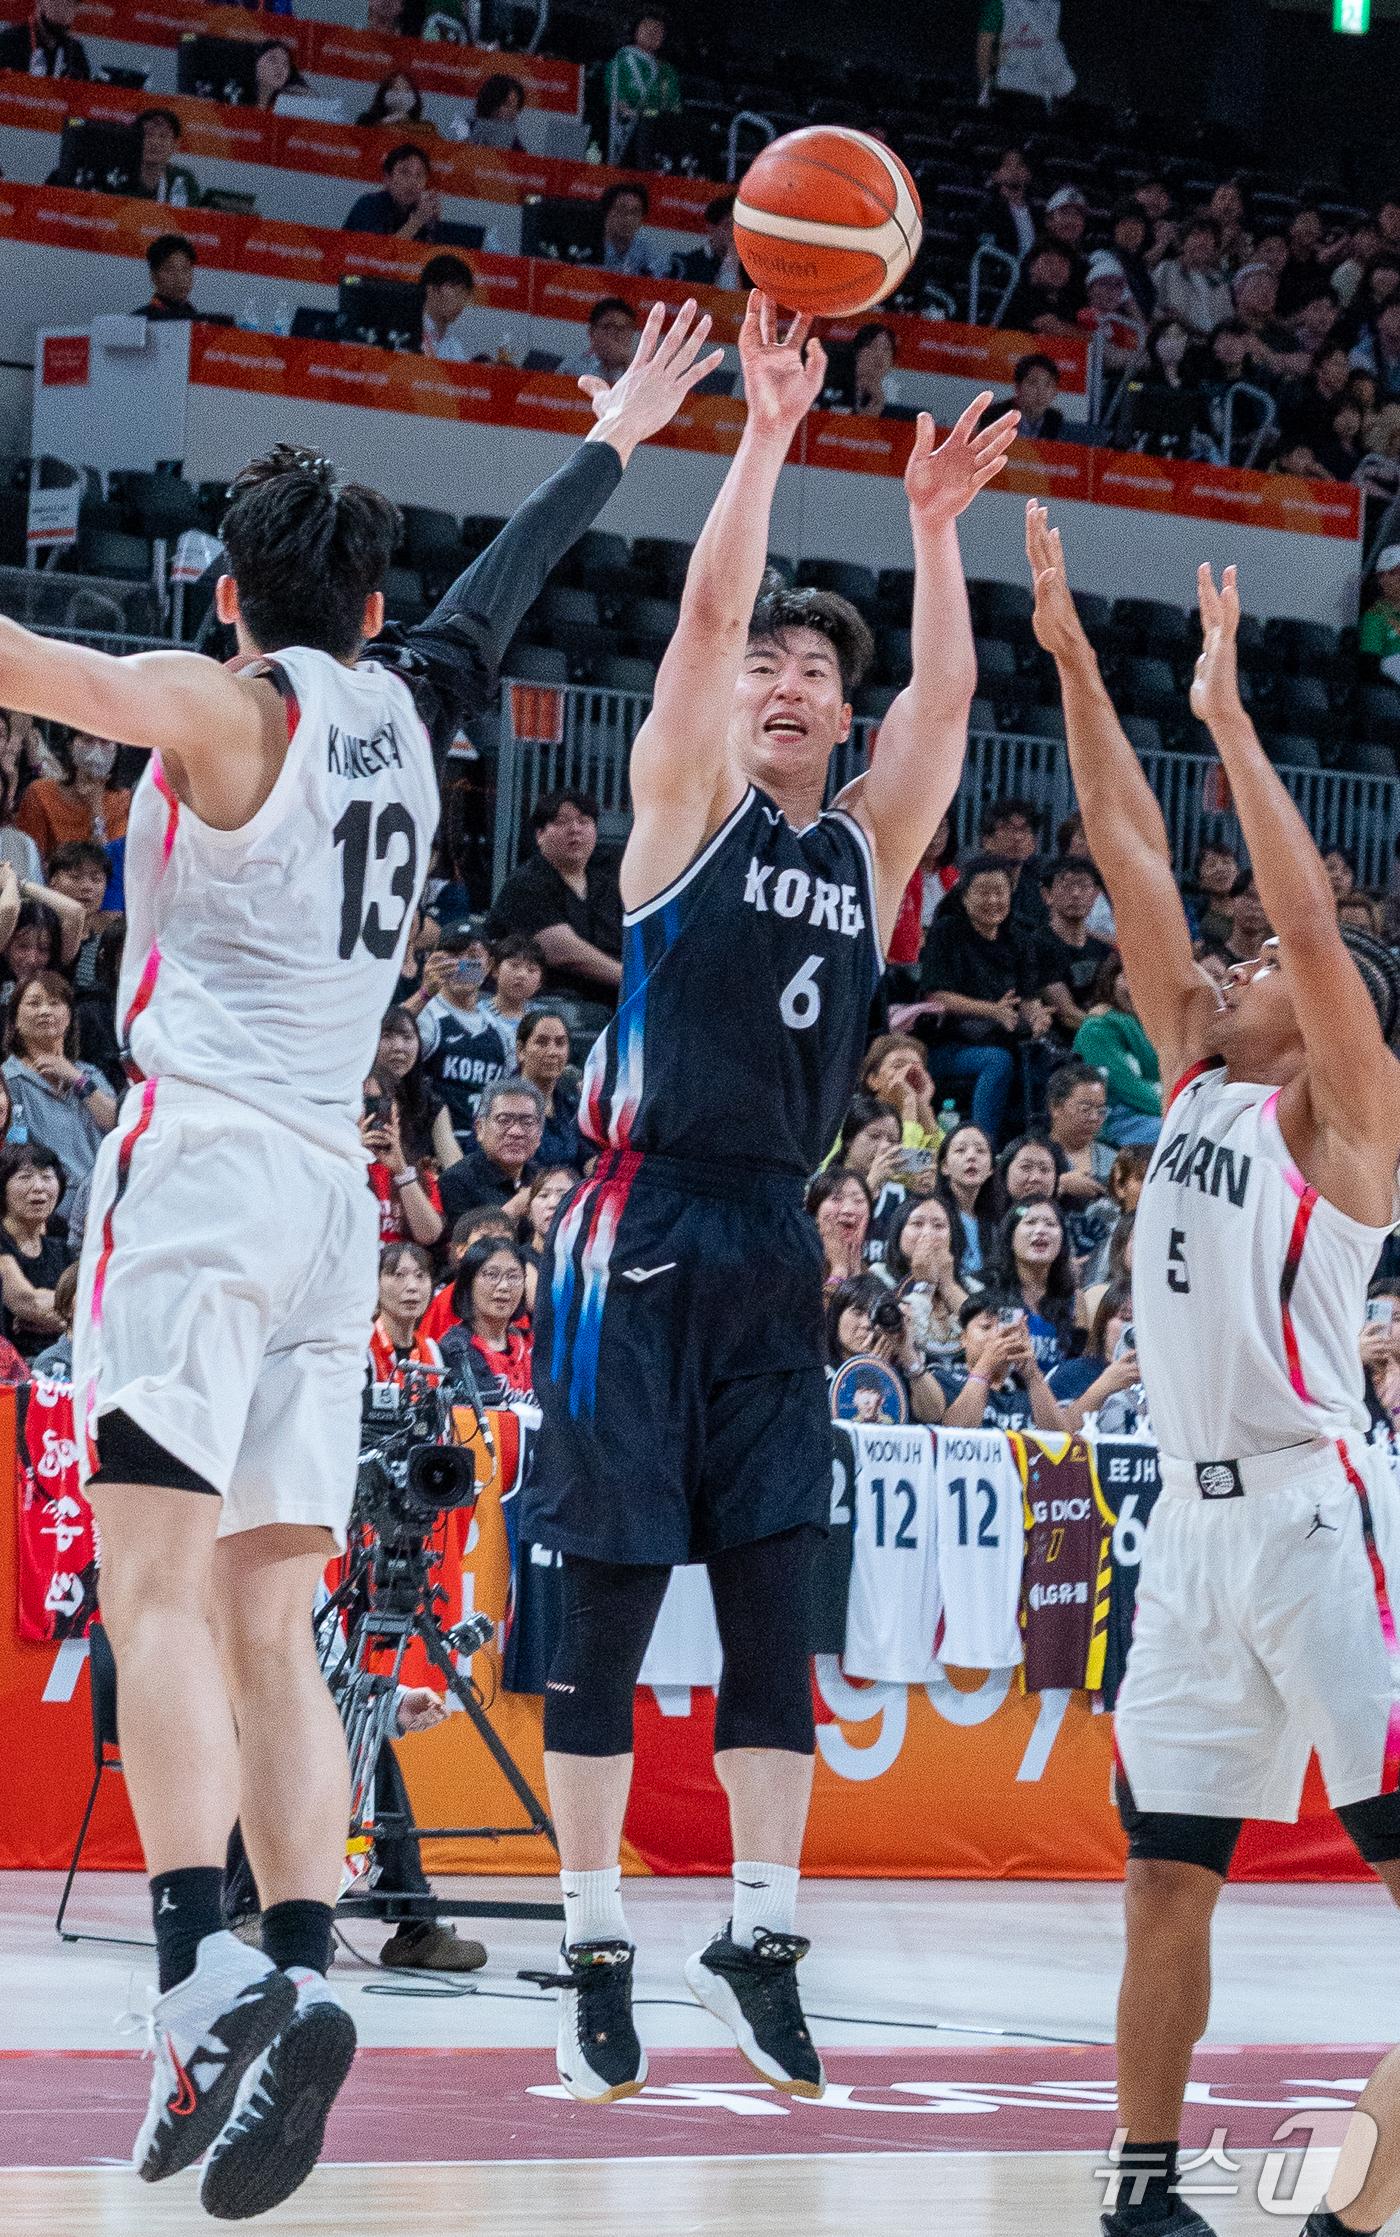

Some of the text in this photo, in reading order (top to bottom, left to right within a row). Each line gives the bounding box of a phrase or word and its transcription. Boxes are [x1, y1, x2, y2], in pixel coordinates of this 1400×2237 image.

[333, 799, 417, 961] 13
[779, 954, 825, 1030] 6
[1167, 1227, 1191, 1294] 5
[904, 1442, 922, 1464] JH
[984, 1440, 1001, 1464] JH
[1132, 1458, 1156, 1483] JH
[871, 1477, 917, 1549] 12
[949, 1477, 999, 1548] 12
[1112, 1493, 1146, 1566] 6
